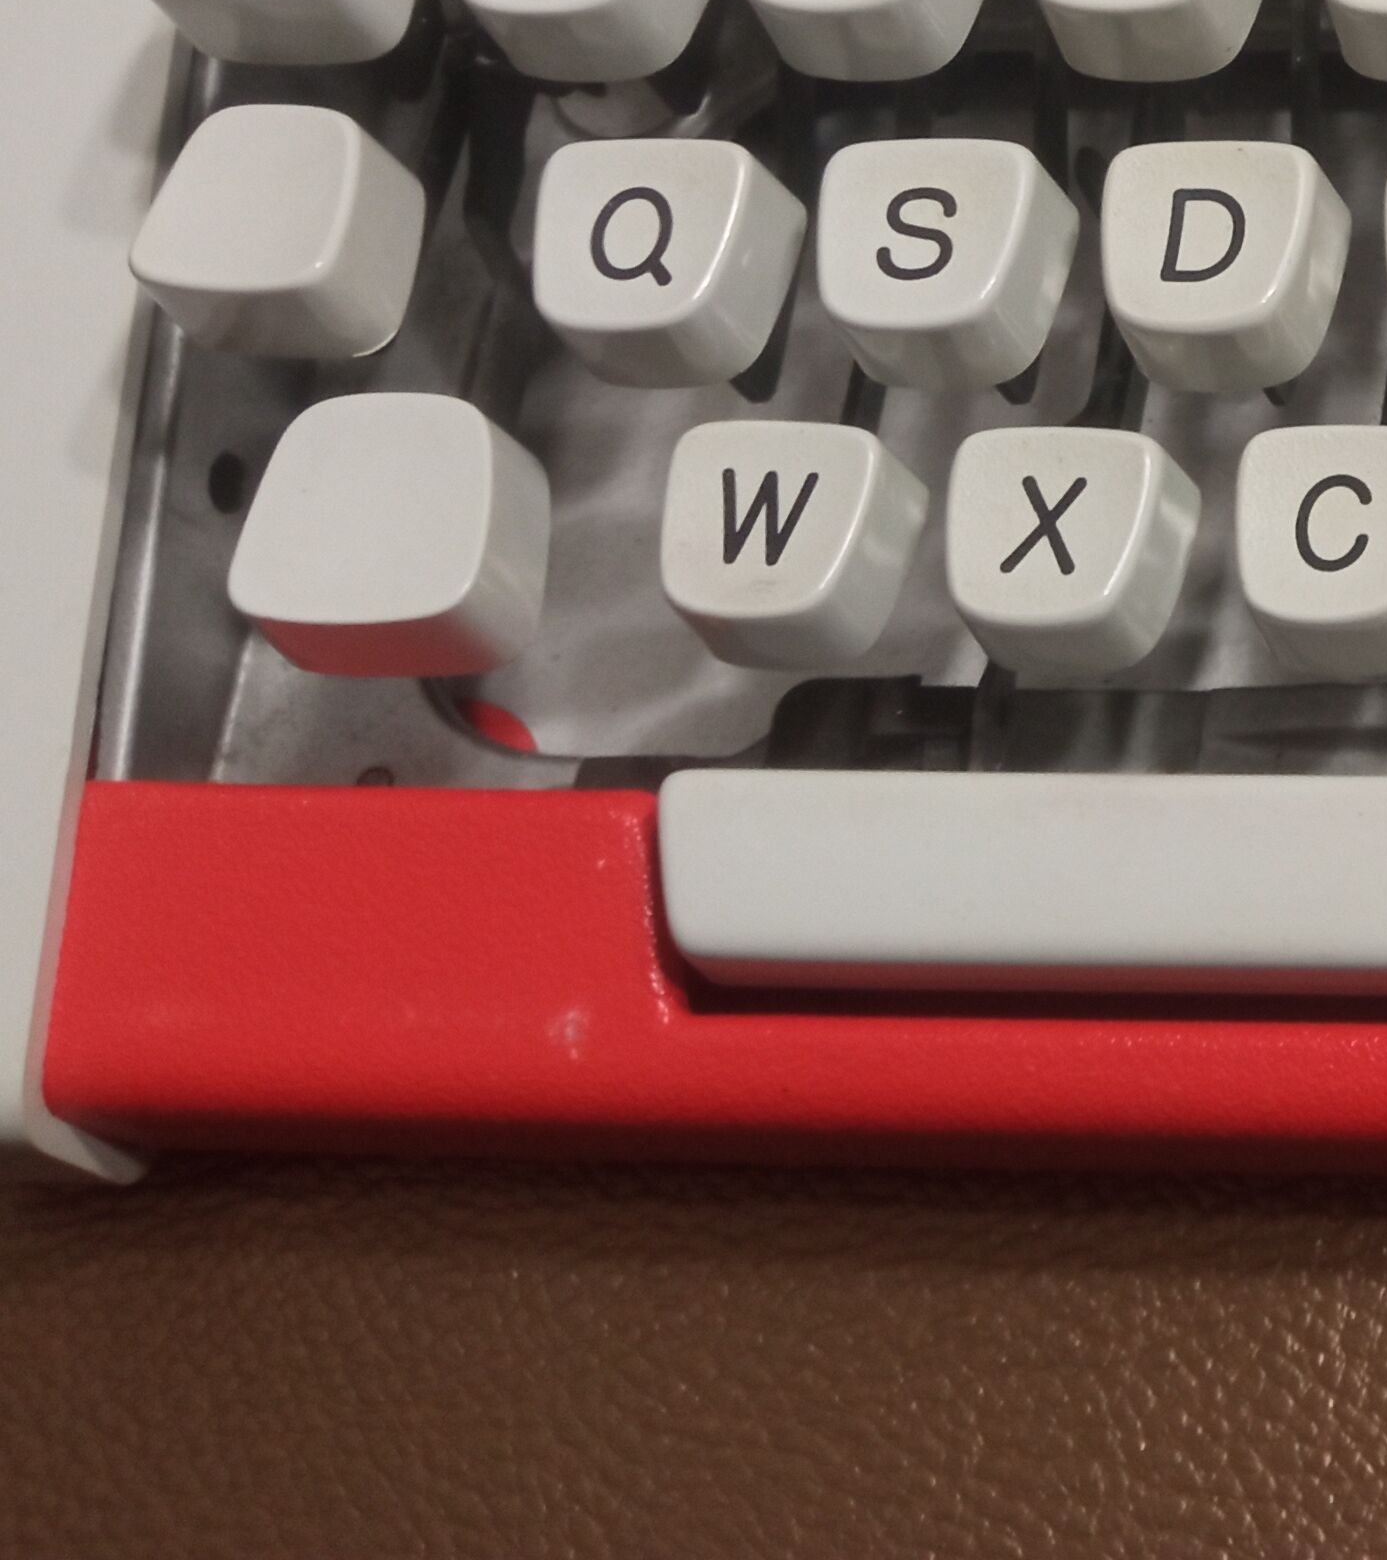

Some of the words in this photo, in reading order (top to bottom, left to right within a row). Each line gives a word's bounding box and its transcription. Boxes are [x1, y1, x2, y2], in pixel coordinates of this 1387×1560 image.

[588, 185, 675, 288] Q
[874, 185, 959, 282] S
[1158, 187, 1247, 284] D
[721, 466, 820, 568] W
[998, 474, 1089, 577] X
[1293, 472, 1374, 574] C
